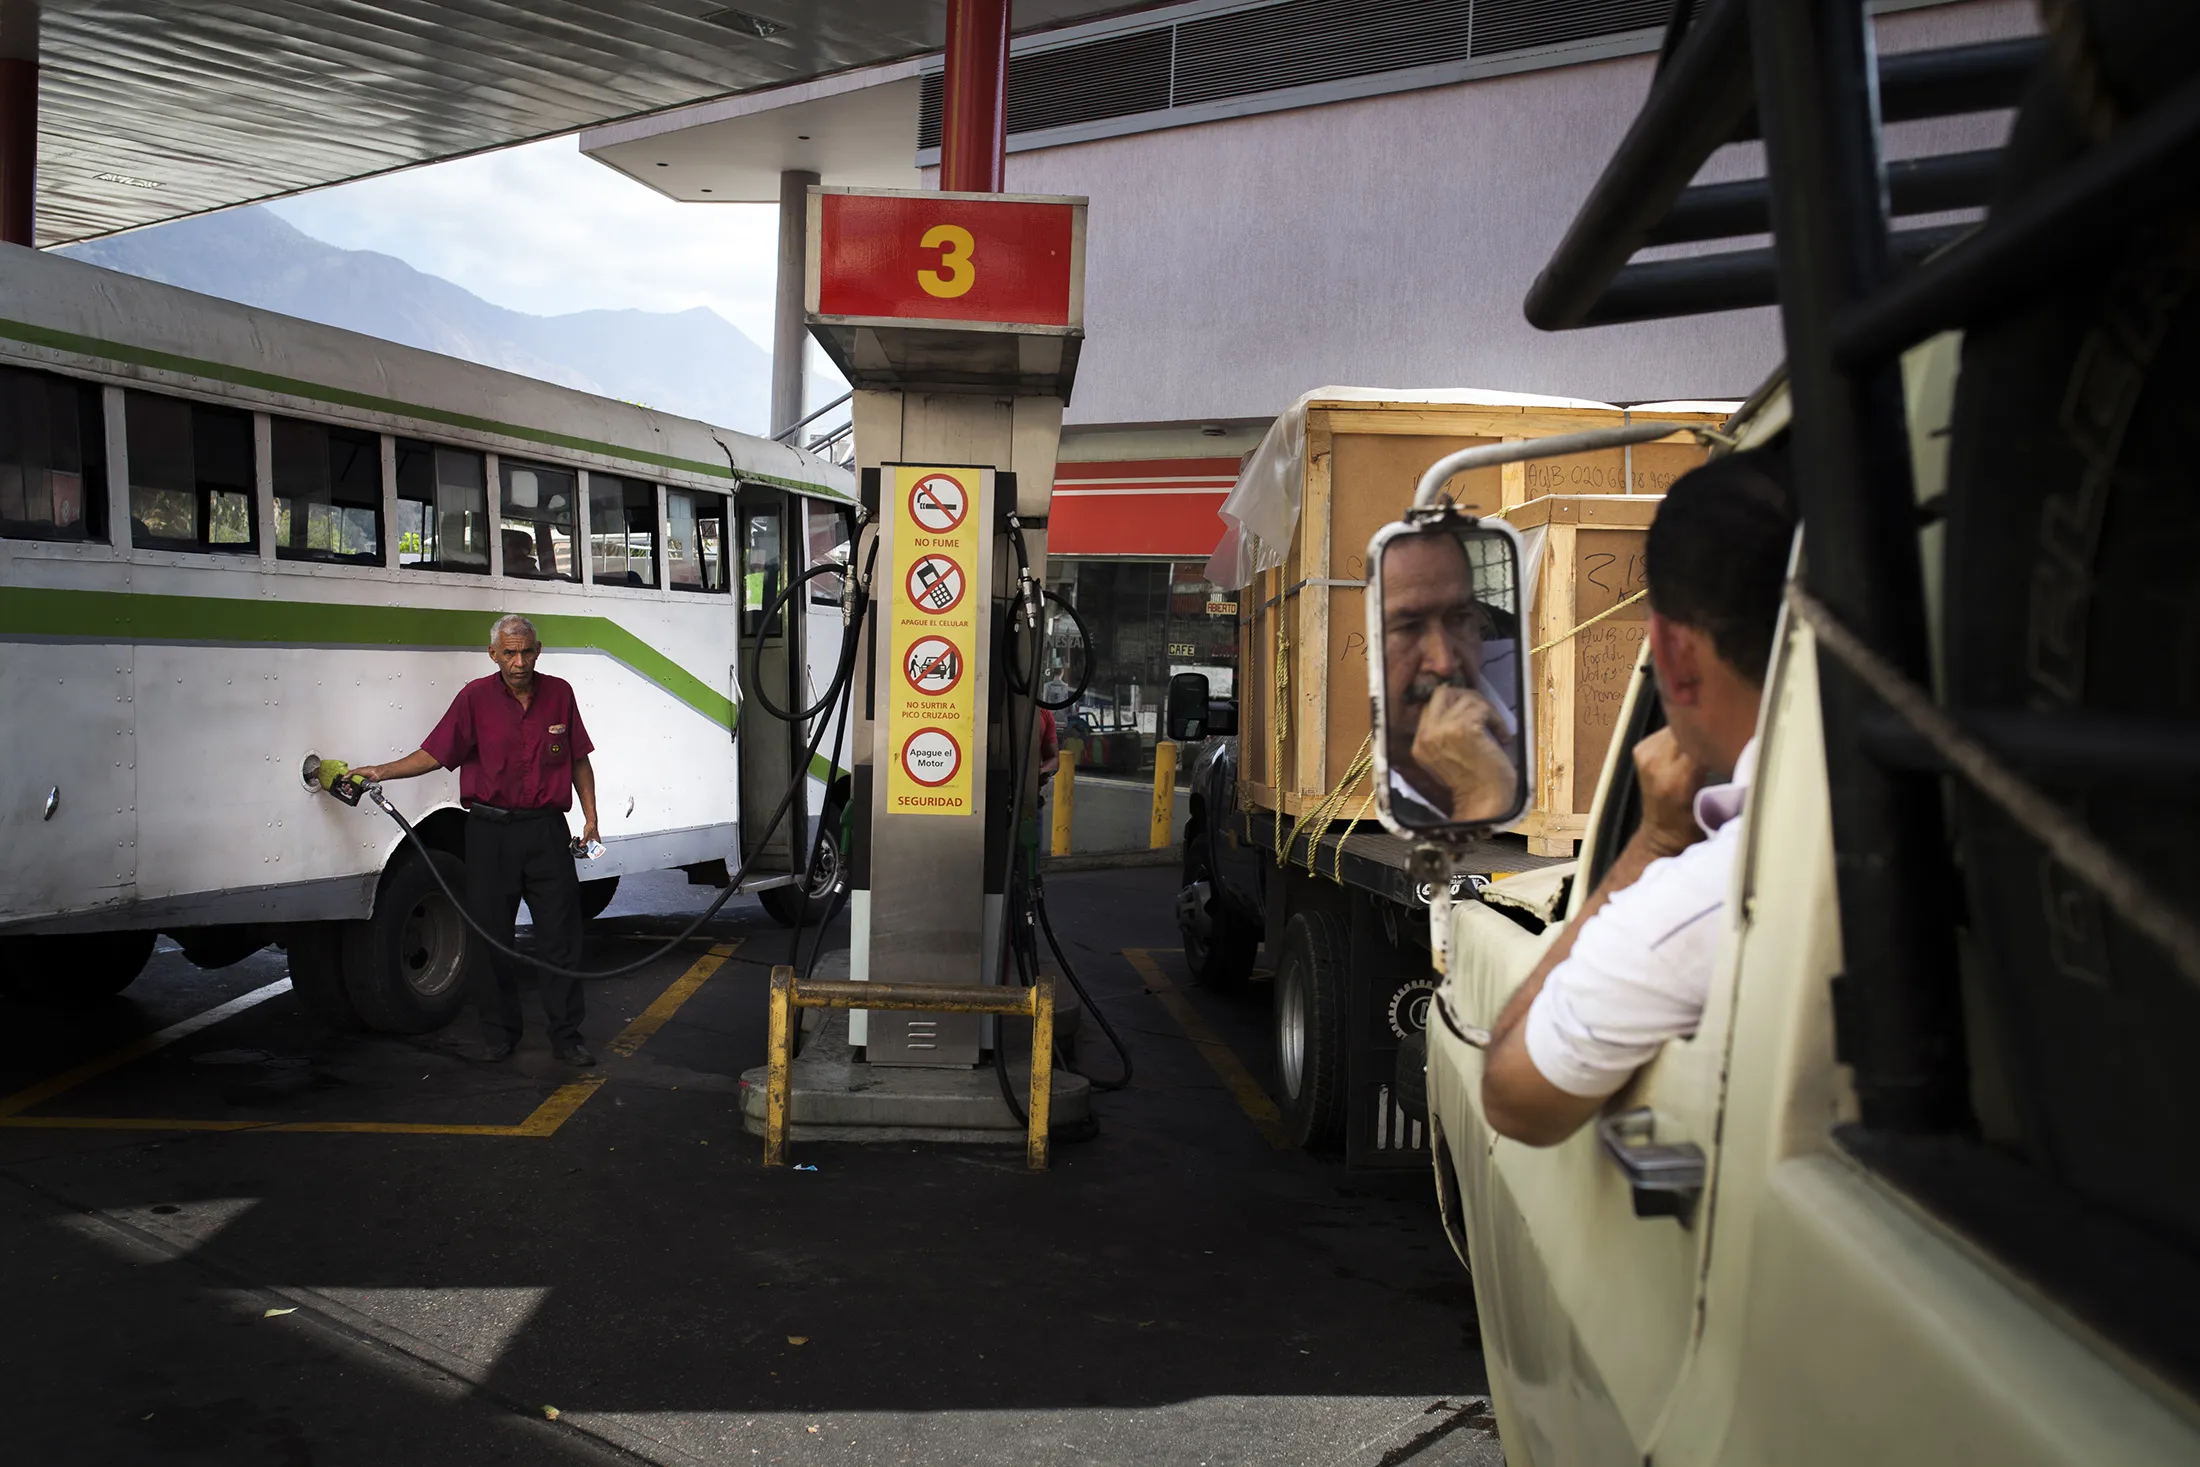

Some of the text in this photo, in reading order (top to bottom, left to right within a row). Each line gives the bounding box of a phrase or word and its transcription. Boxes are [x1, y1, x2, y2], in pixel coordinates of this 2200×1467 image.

[917, 224, 976, 298] 3
[1528, 463, 1565, 488] AWB
[1571, 465, 1604, 488] 020
[914, 538, 960, 548] NO FUME
[1207, 603, 1236, 613] ABIERTO
[901, 619, 928, 627] APAGUE
[1168, 645, 1194, 655] CAFE
[906, 701, 956, 710] NO SURTIR A
[901, 711, 960, 720] PICO CRUZADO
[909, 748, 952, 758] Apague el
[917, 759, 944, 768] Motor
[898, 796, 963, 807] SEGURIDAD
